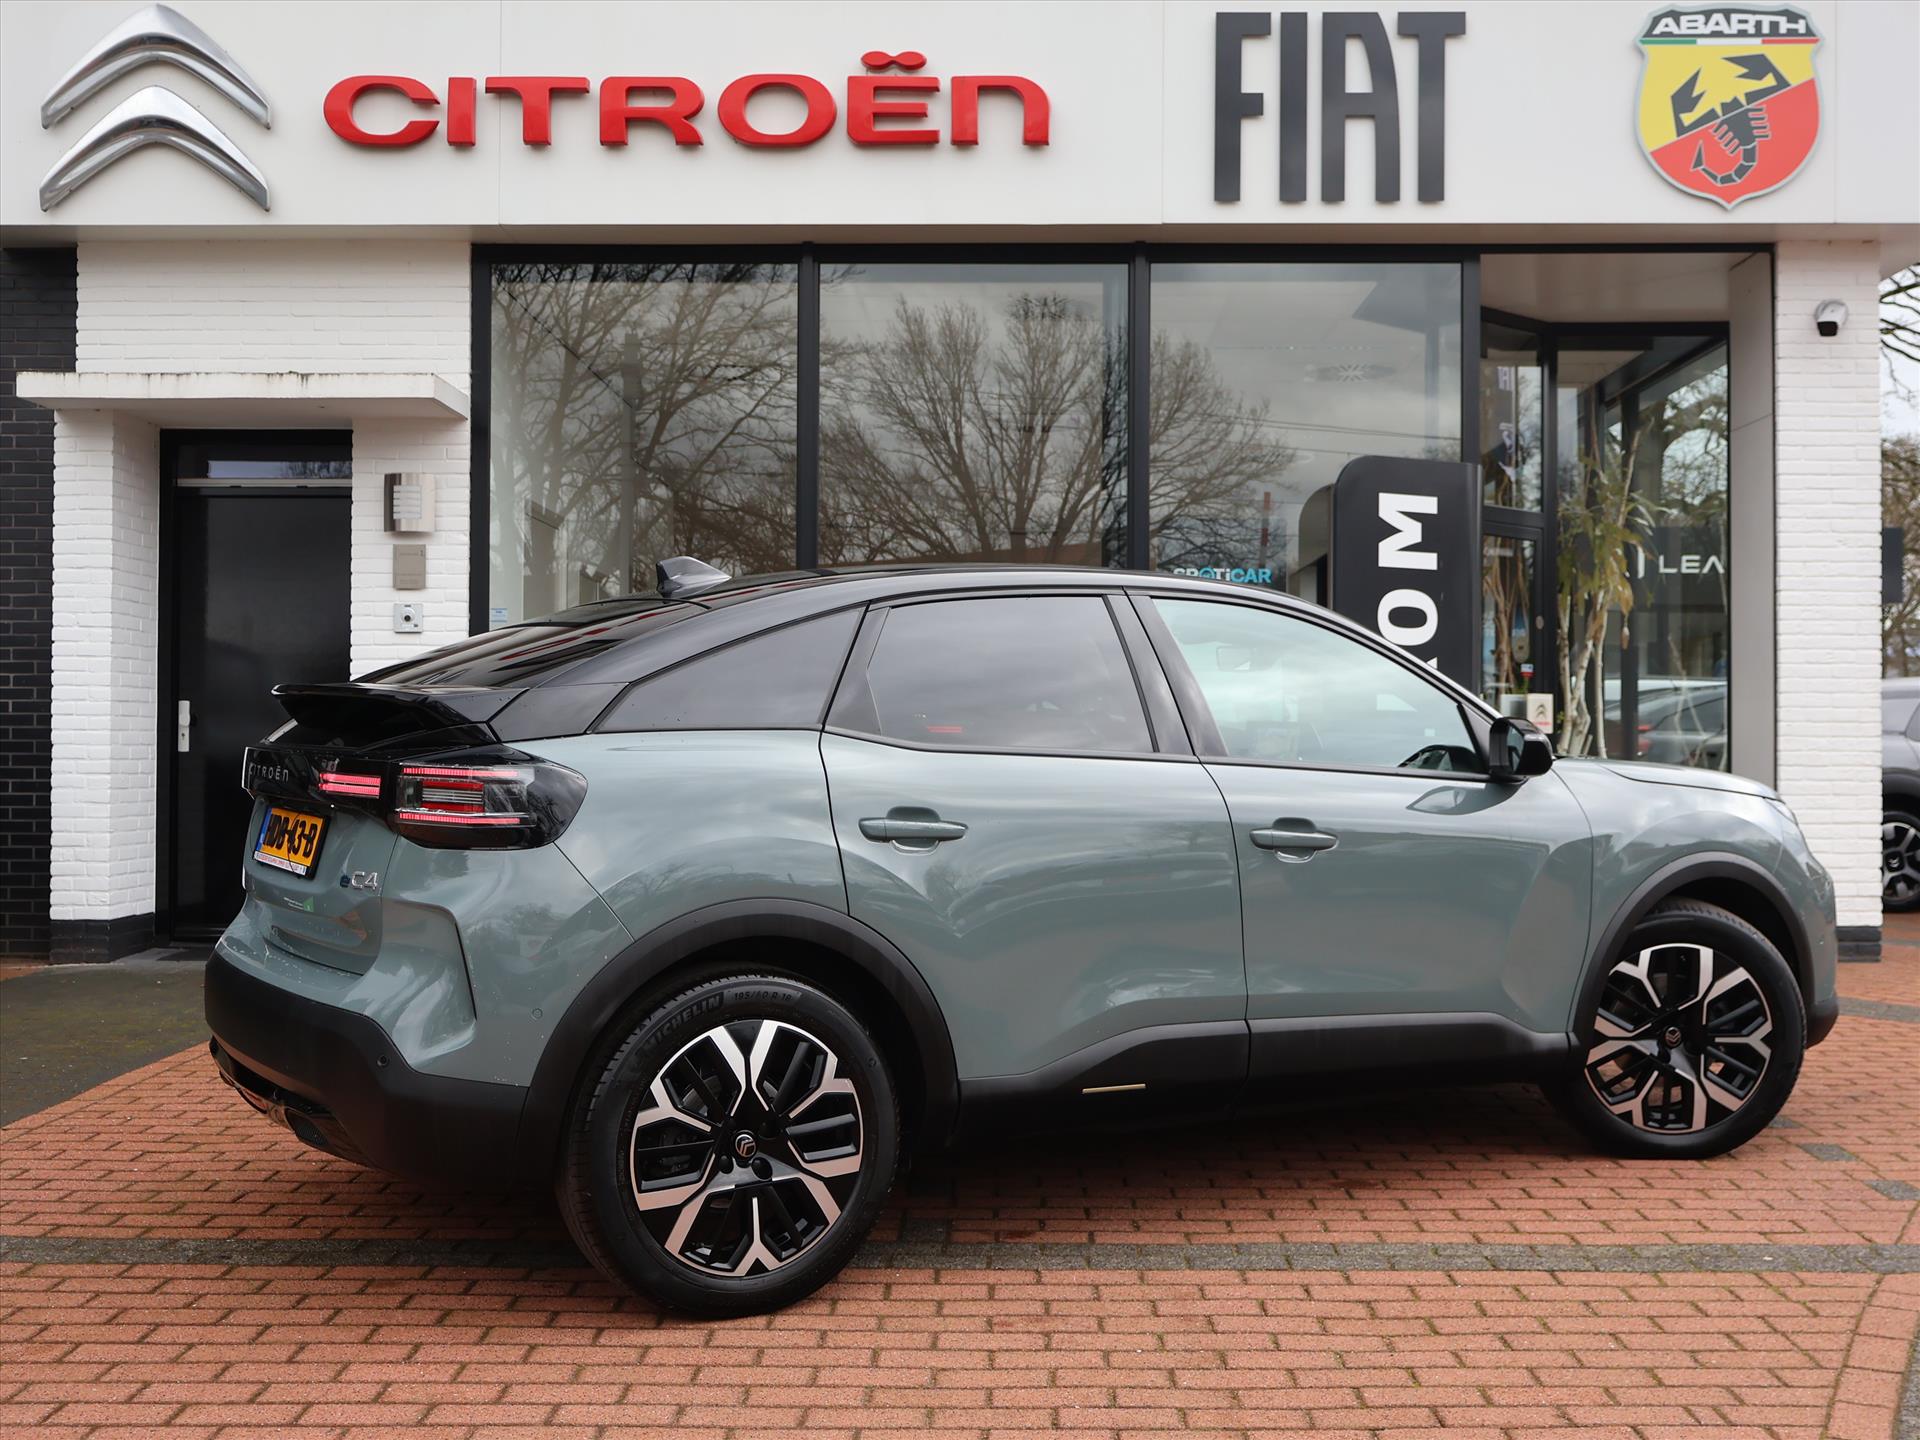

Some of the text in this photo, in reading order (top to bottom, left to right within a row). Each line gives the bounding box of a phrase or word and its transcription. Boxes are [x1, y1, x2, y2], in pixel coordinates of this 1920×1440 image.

[1652, 12, 1806, 35] ABARTH
[1214, 12, 1466, 203] FIAT
[1377, 492, 1438, 669] OM
[351, 870, 378, 890] C4
